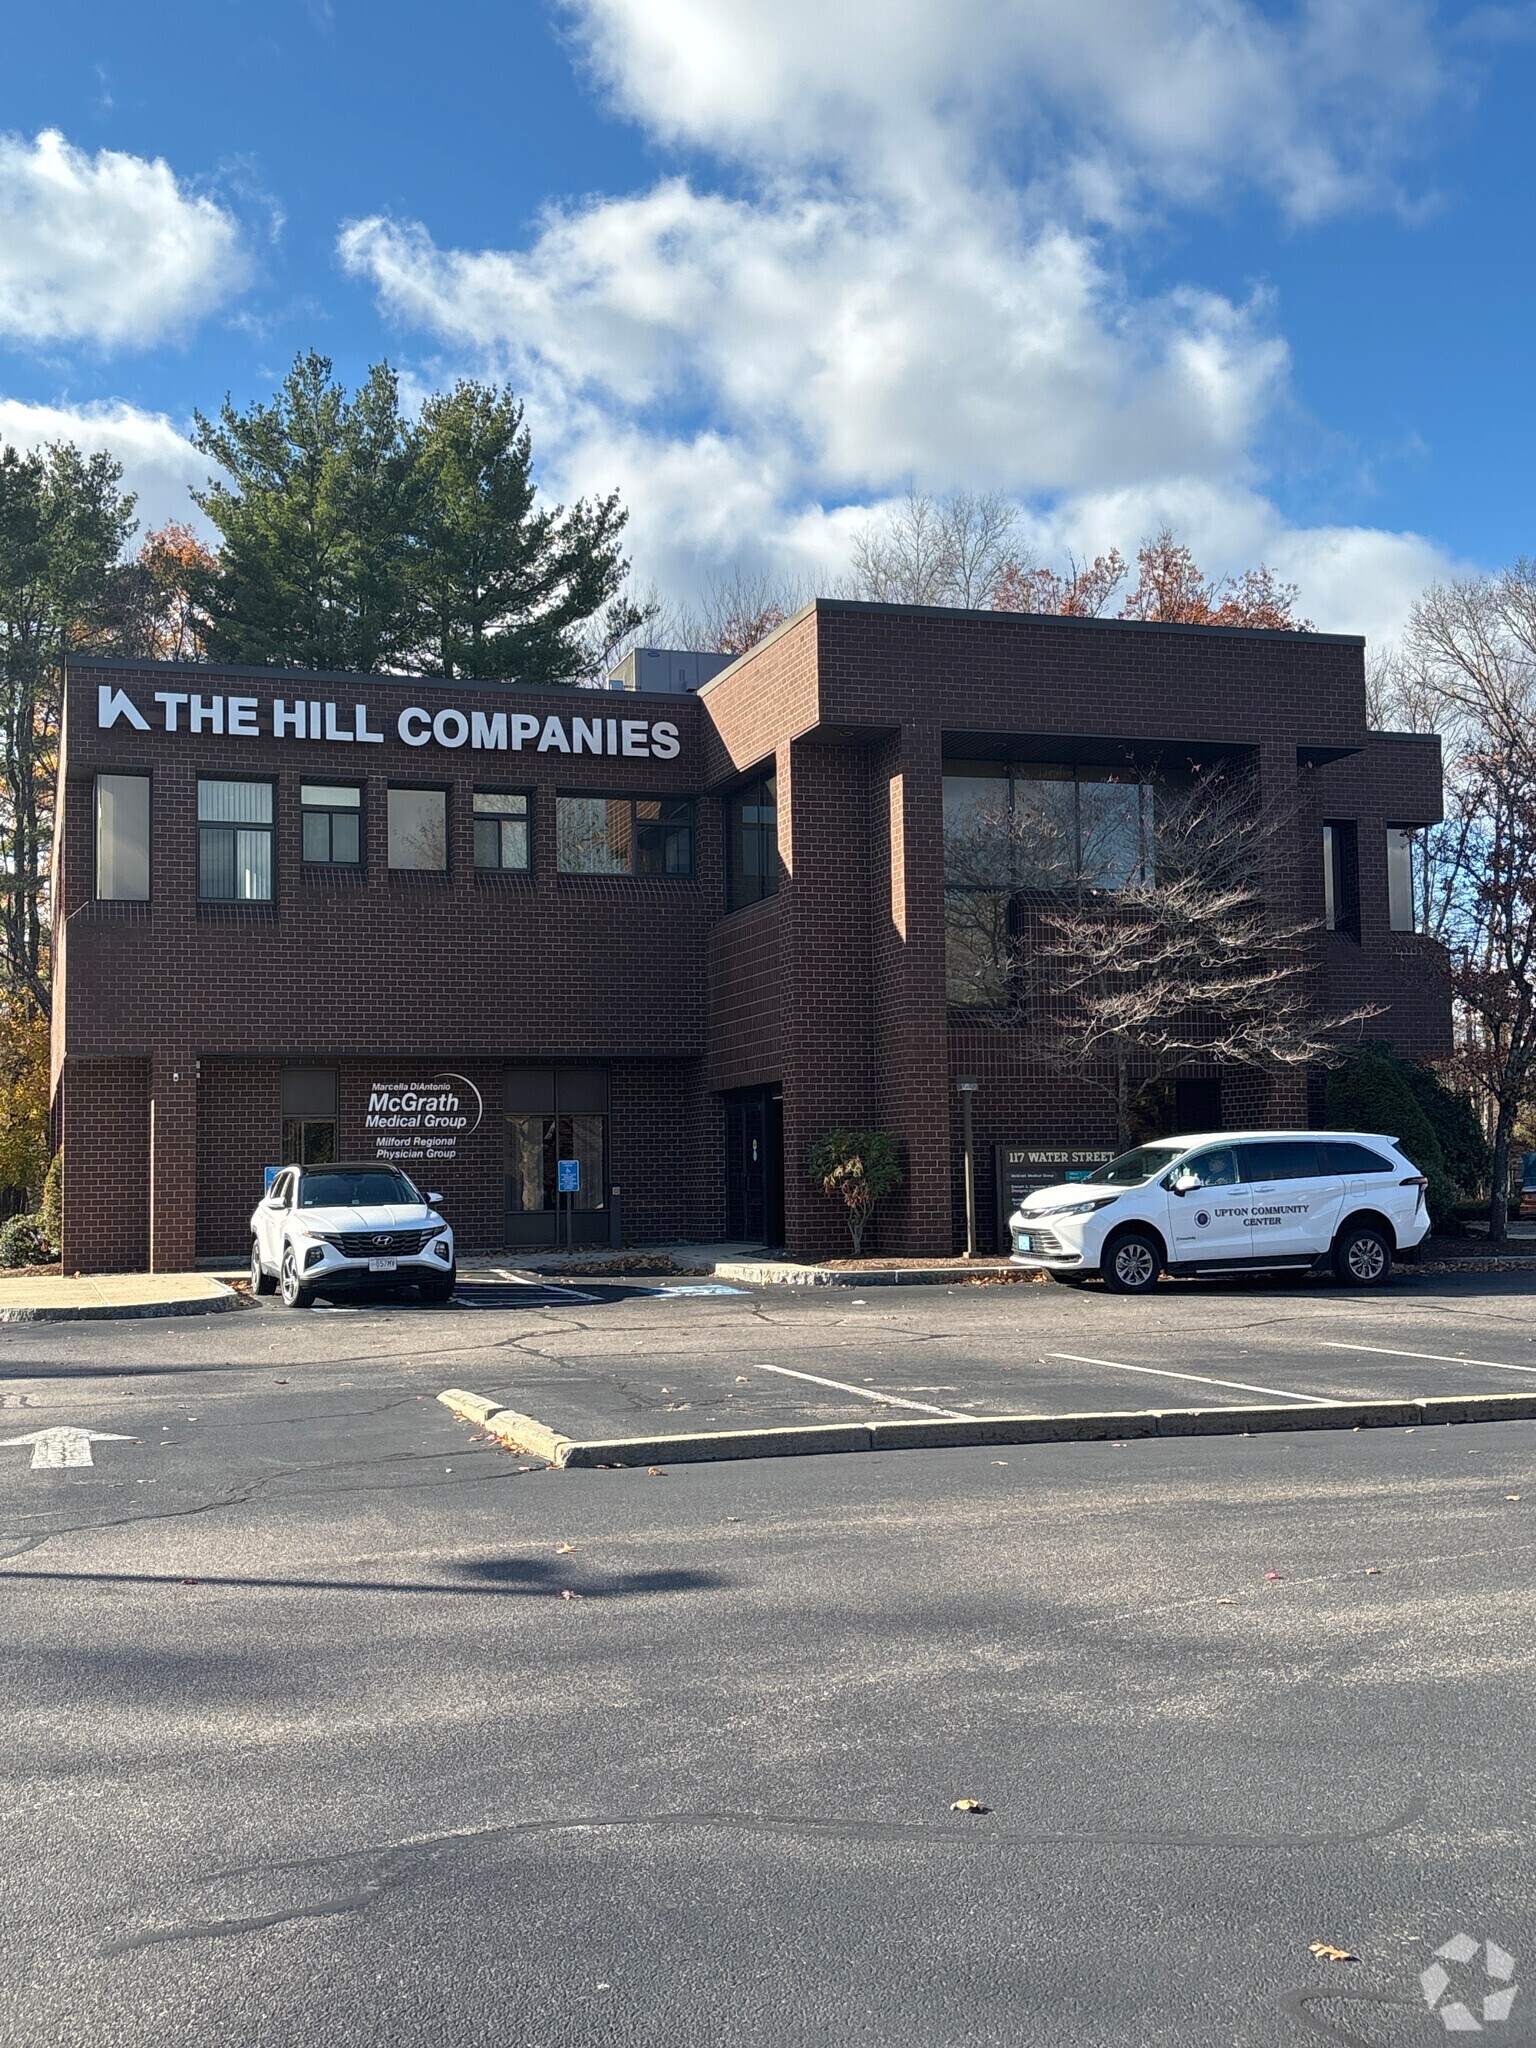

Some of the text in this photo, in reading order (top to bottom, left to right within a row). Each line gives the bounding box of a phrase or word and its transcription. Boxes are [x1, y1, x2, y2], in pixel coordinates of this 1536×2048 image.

[155, 692, 681, 759] THE HILL COMPANIES
[372, 1083, 451, 1091] Marcella DiAntonio
[368, 1093, 459, 1112] McGrath
[365, 1114, 467, 1129] Medical Group
[376, 1137, 457, 1148] Milford Regional
[376, 1149, 457, 1160] Physician Group
[1009, 1151, 1115, 1163] 117 WATER STREET
[1214, 1205, 1310, 1217] UPTON COMMUNITY
[1243, 1217, 1282, 1227] CENTER
